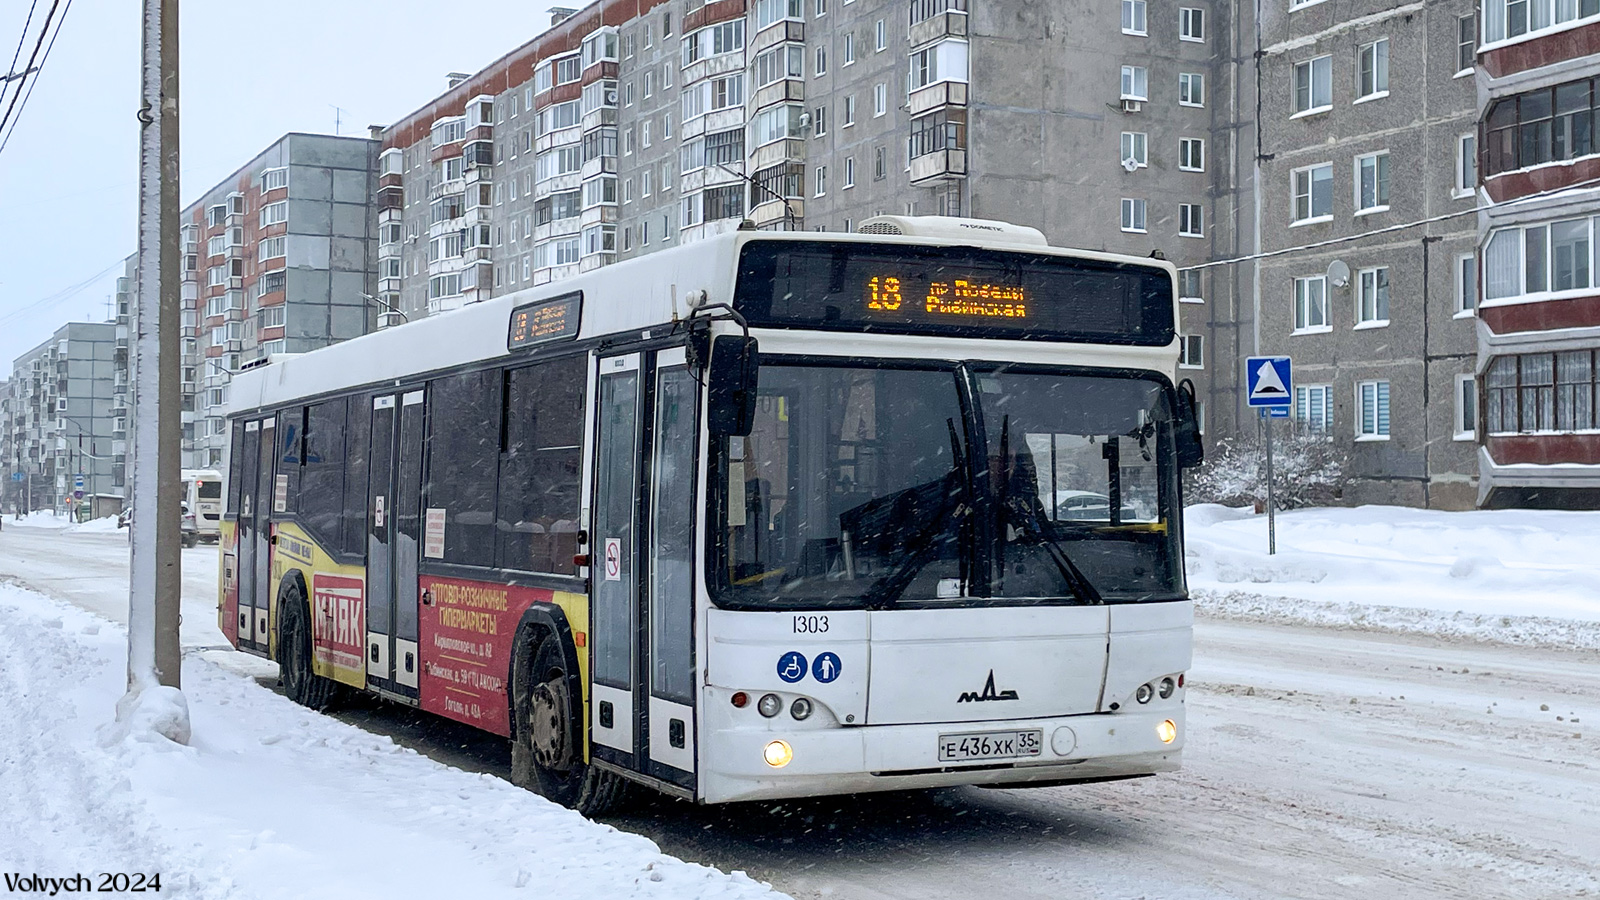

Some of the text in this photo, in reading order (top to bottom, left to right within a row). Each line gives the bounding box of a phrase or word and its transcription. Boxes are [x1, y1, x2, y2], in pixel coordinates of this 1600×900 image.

[868, 276, 902, 310] 18
[954, 280, 1024, 300] Победы
[926, 296, 1026, 317] Рыбинская
[315, 594, 361, 647] МАЯК
[440, 607, 497, 635] ГИПЕРМАРКЕТЫ
[793, 615, 829, 633] 1303
[1019, 733, 1034, 747] 35
